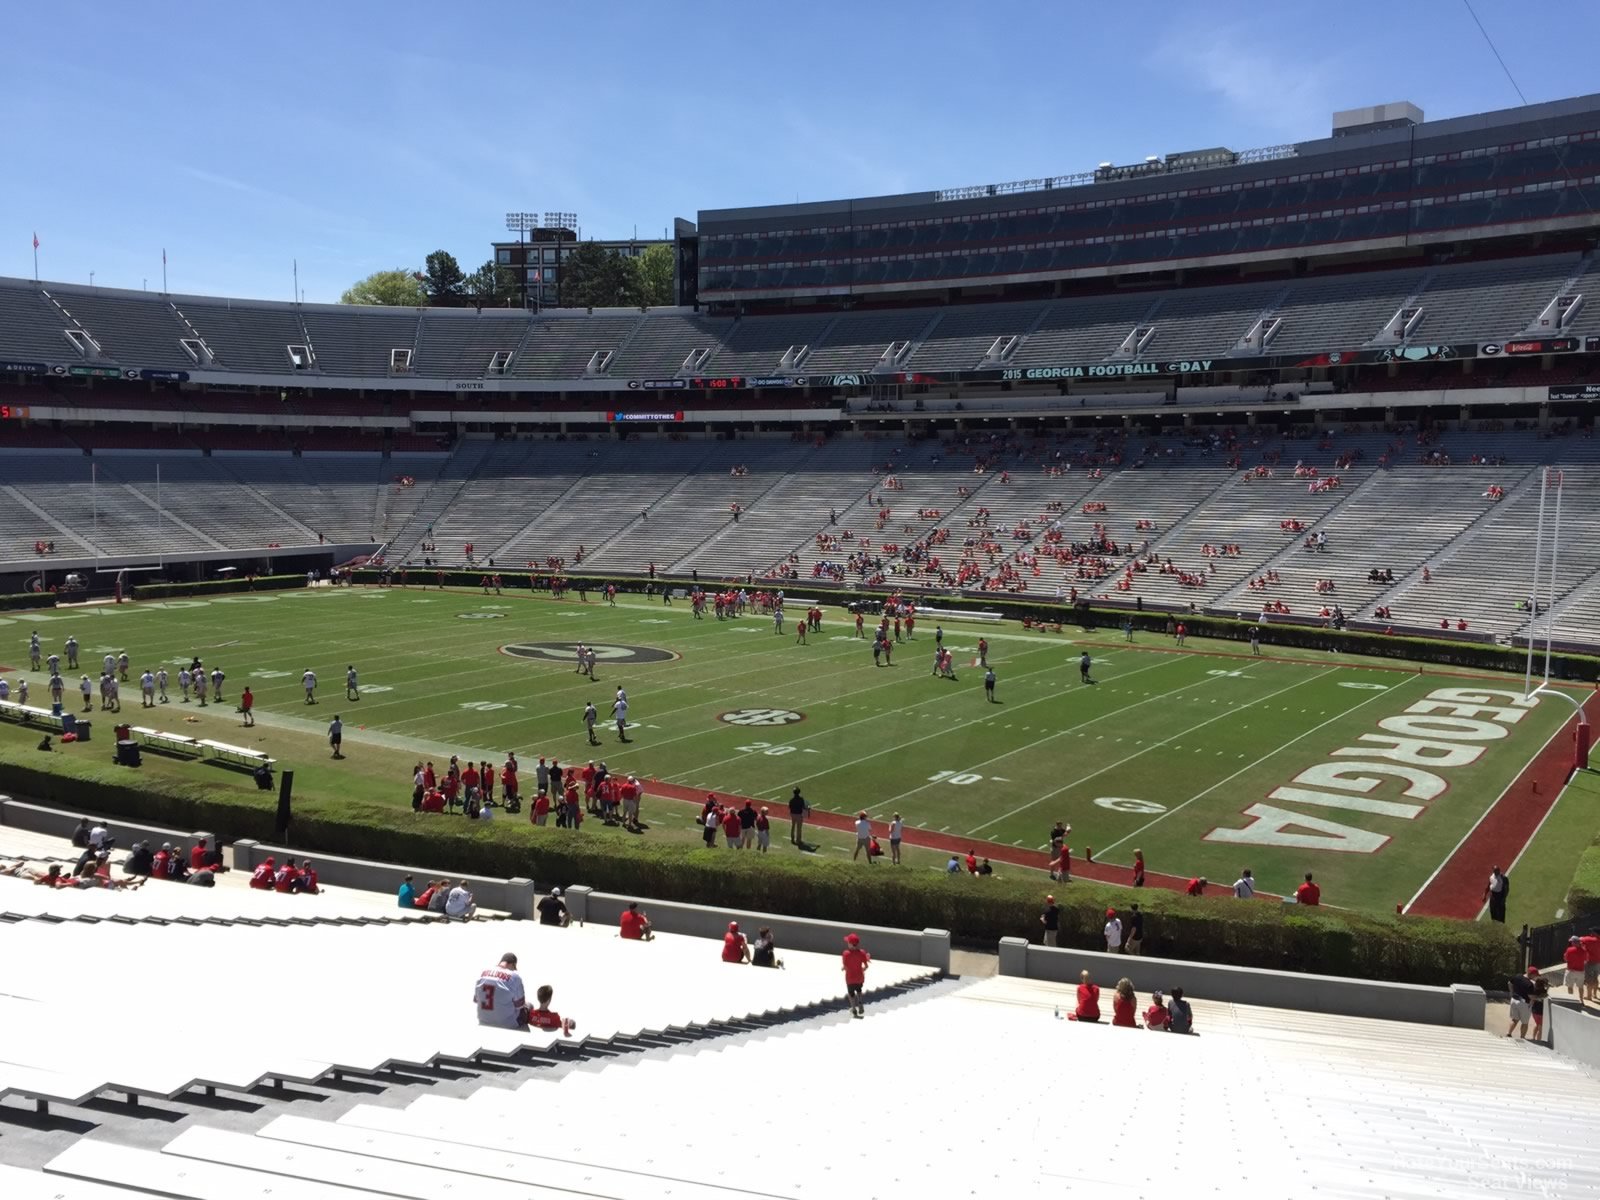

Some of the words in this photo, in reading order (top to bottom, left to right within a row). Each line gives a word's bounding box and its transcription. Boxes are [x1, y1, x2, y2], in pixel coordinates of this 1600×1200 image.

[1003, 370, 1022, 379] 2015
[1027, 367, 1084, 378] GEORGIA
[1089, 364, 1159, 376] FOOTBALL
[734, 742, 797, 755] 20
[928, 770, 983, 784] 10
[1202, 687, 1540, 853] GEORGIA
[481, 984, 495, 1011] 3
